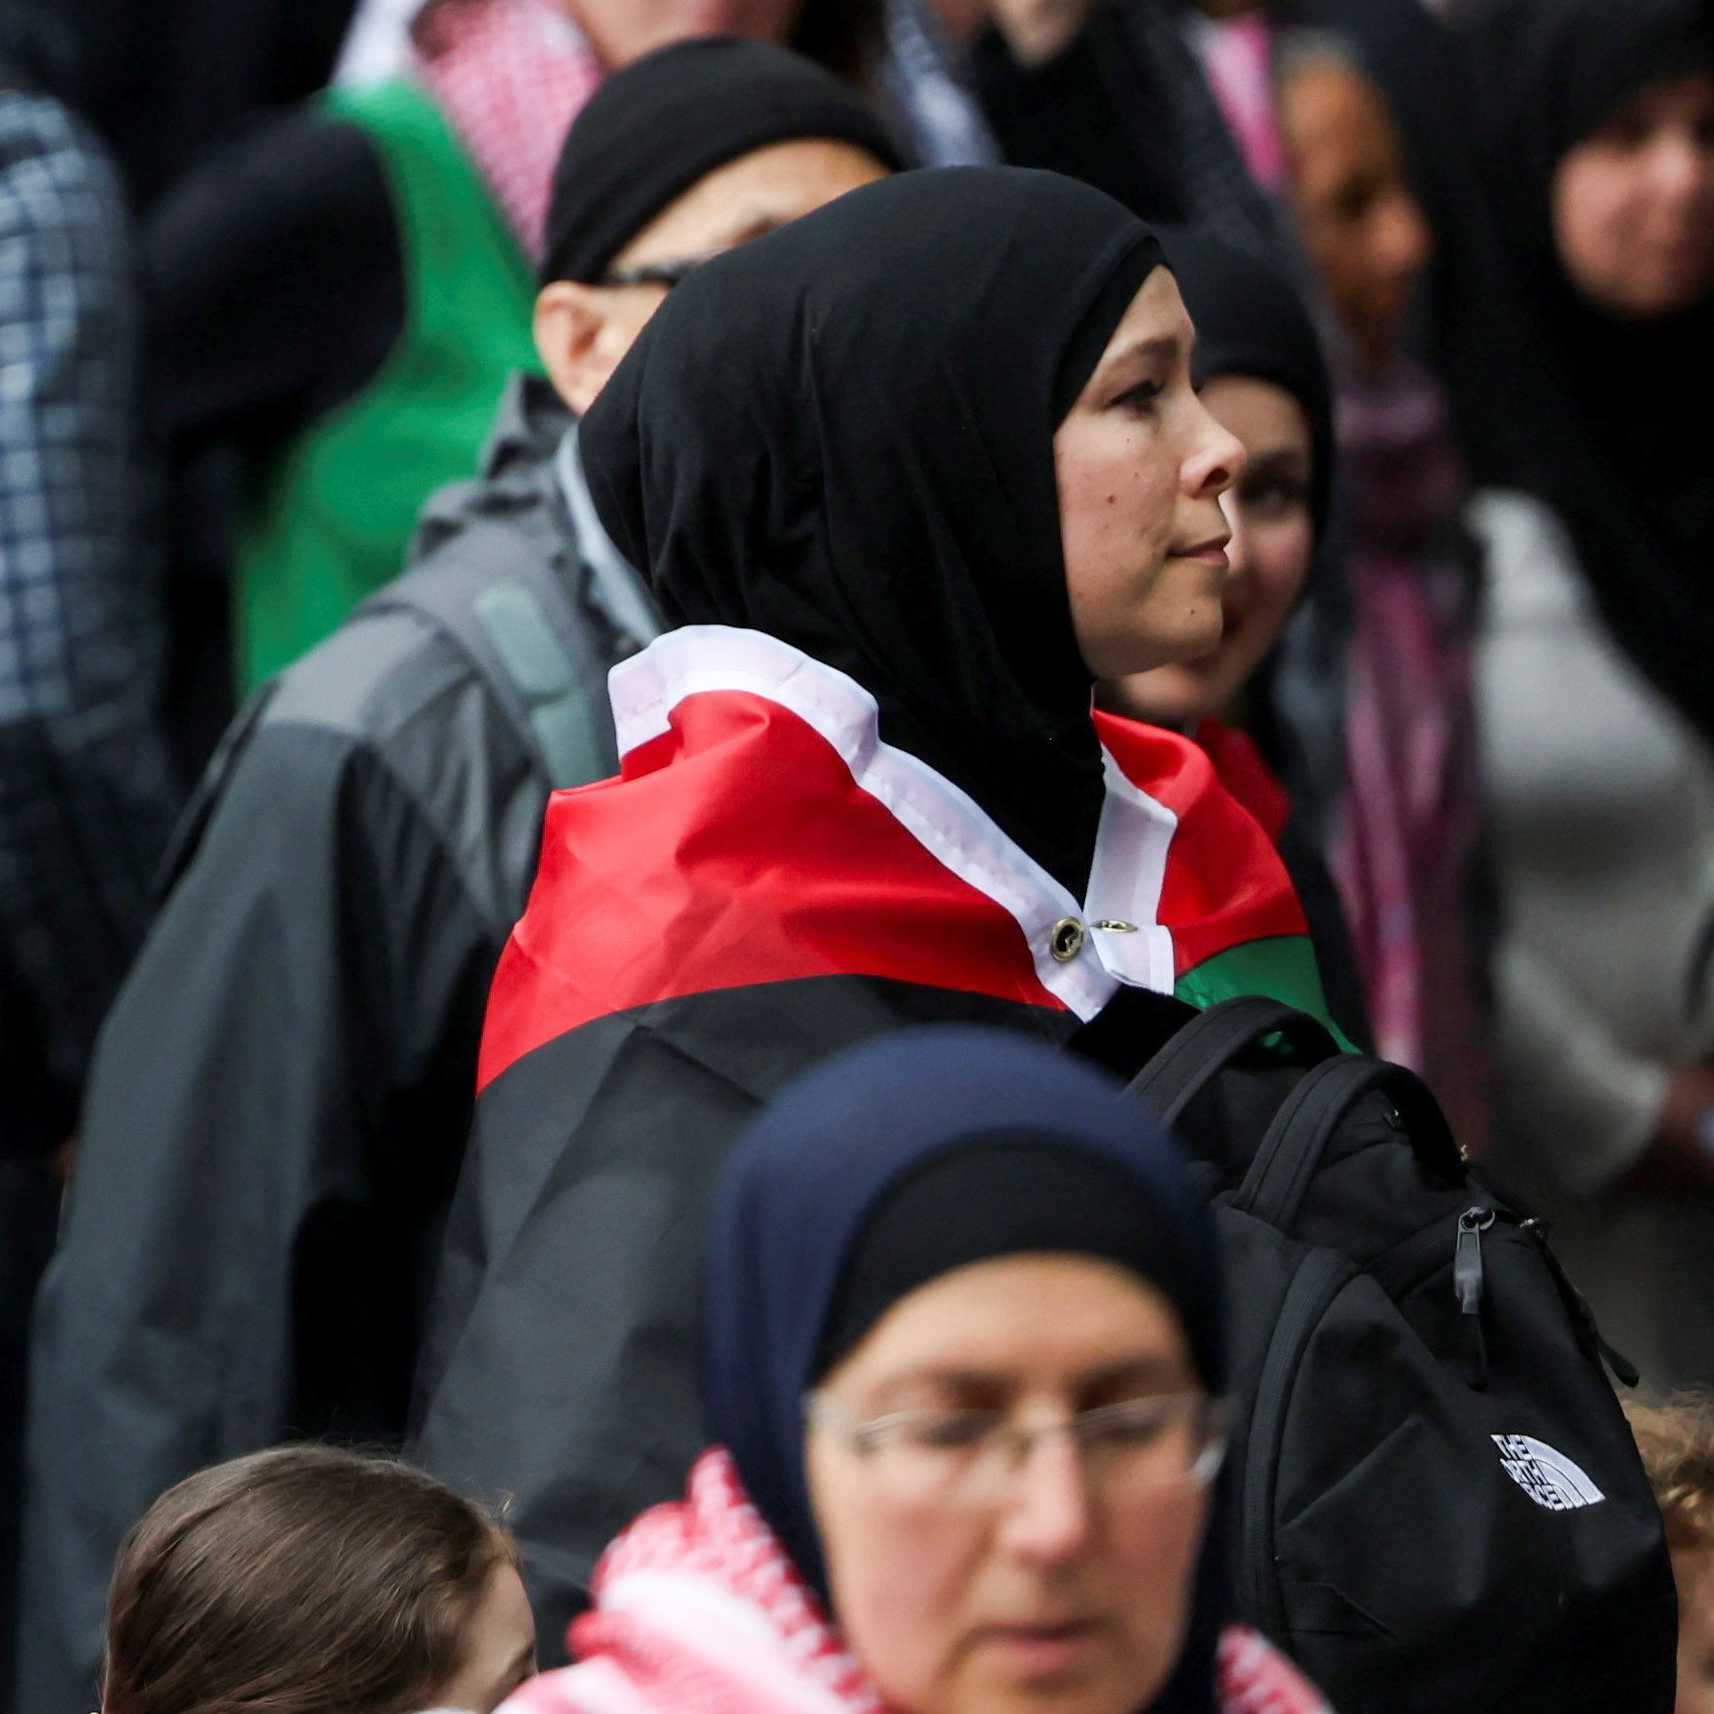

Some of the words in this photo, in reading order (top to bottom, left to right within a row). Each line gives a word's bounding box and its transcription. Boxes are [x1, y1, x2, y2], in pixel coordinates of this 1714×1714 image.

[1490, 1433, 1534, 1460] THE
[1499, 1457, 1549, 1486] ORTH
[1521, 1483, 1566, 1512] ACE
